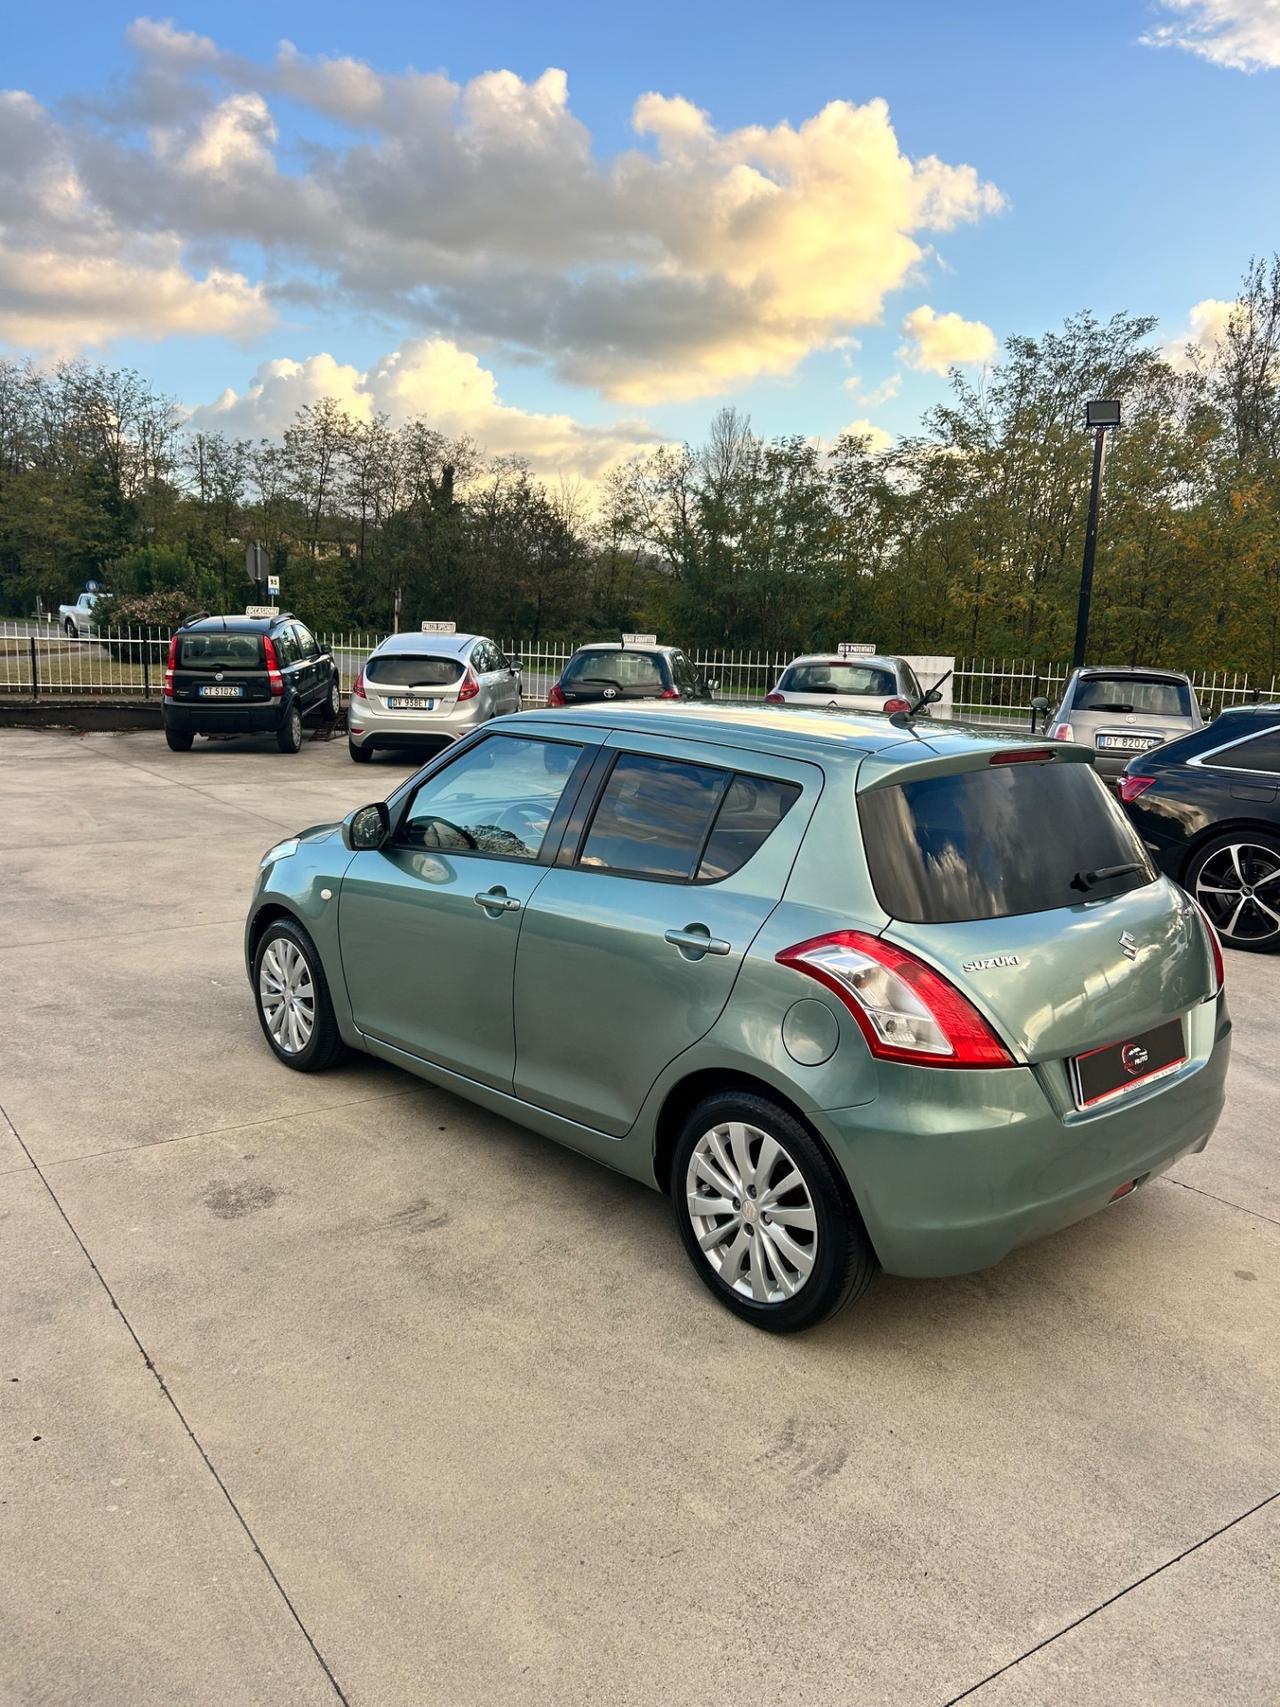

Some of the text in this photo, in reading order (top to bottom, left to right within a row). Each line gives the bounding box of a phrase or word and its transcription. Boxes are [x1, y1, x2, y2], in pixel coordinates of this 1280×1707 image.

[203, 687, 213, 695] CT
[393, 698, 402, 706] DV
[1106, 737, 1118, 746] DY
[962, 956, 1020, 972] SUZUKI
